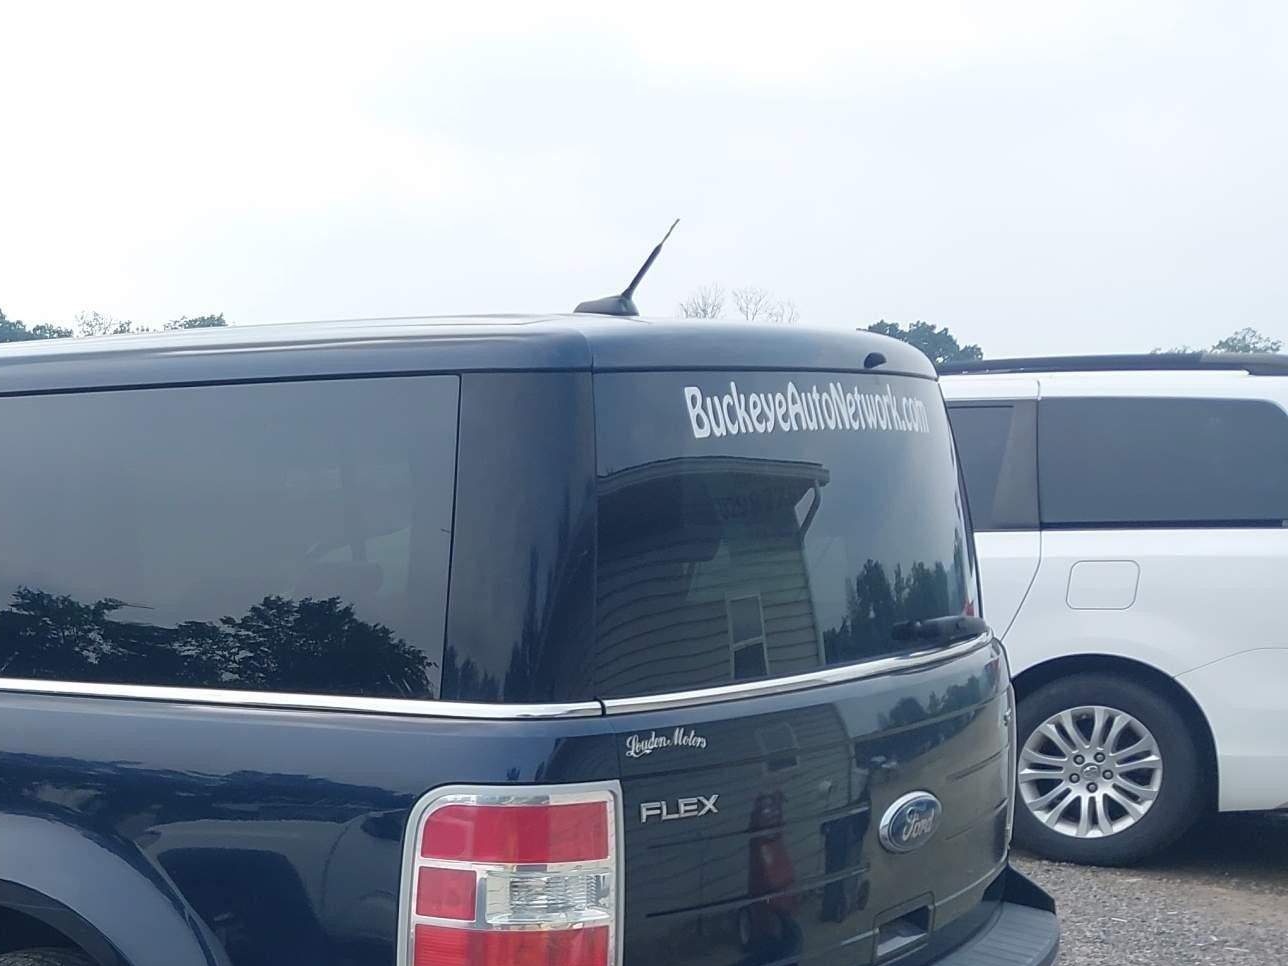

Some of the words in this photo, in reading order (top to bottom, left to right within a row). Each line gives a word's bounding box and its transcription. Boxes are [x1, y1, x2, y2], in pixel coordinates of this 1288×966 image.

[683, 381, 930, 439] BuckeyeAutoNetwork.com
[672, 727, 707, 749] Motors
[640, 794, 720, 823] FLEX
[902, 803, 934, 842] Ford
